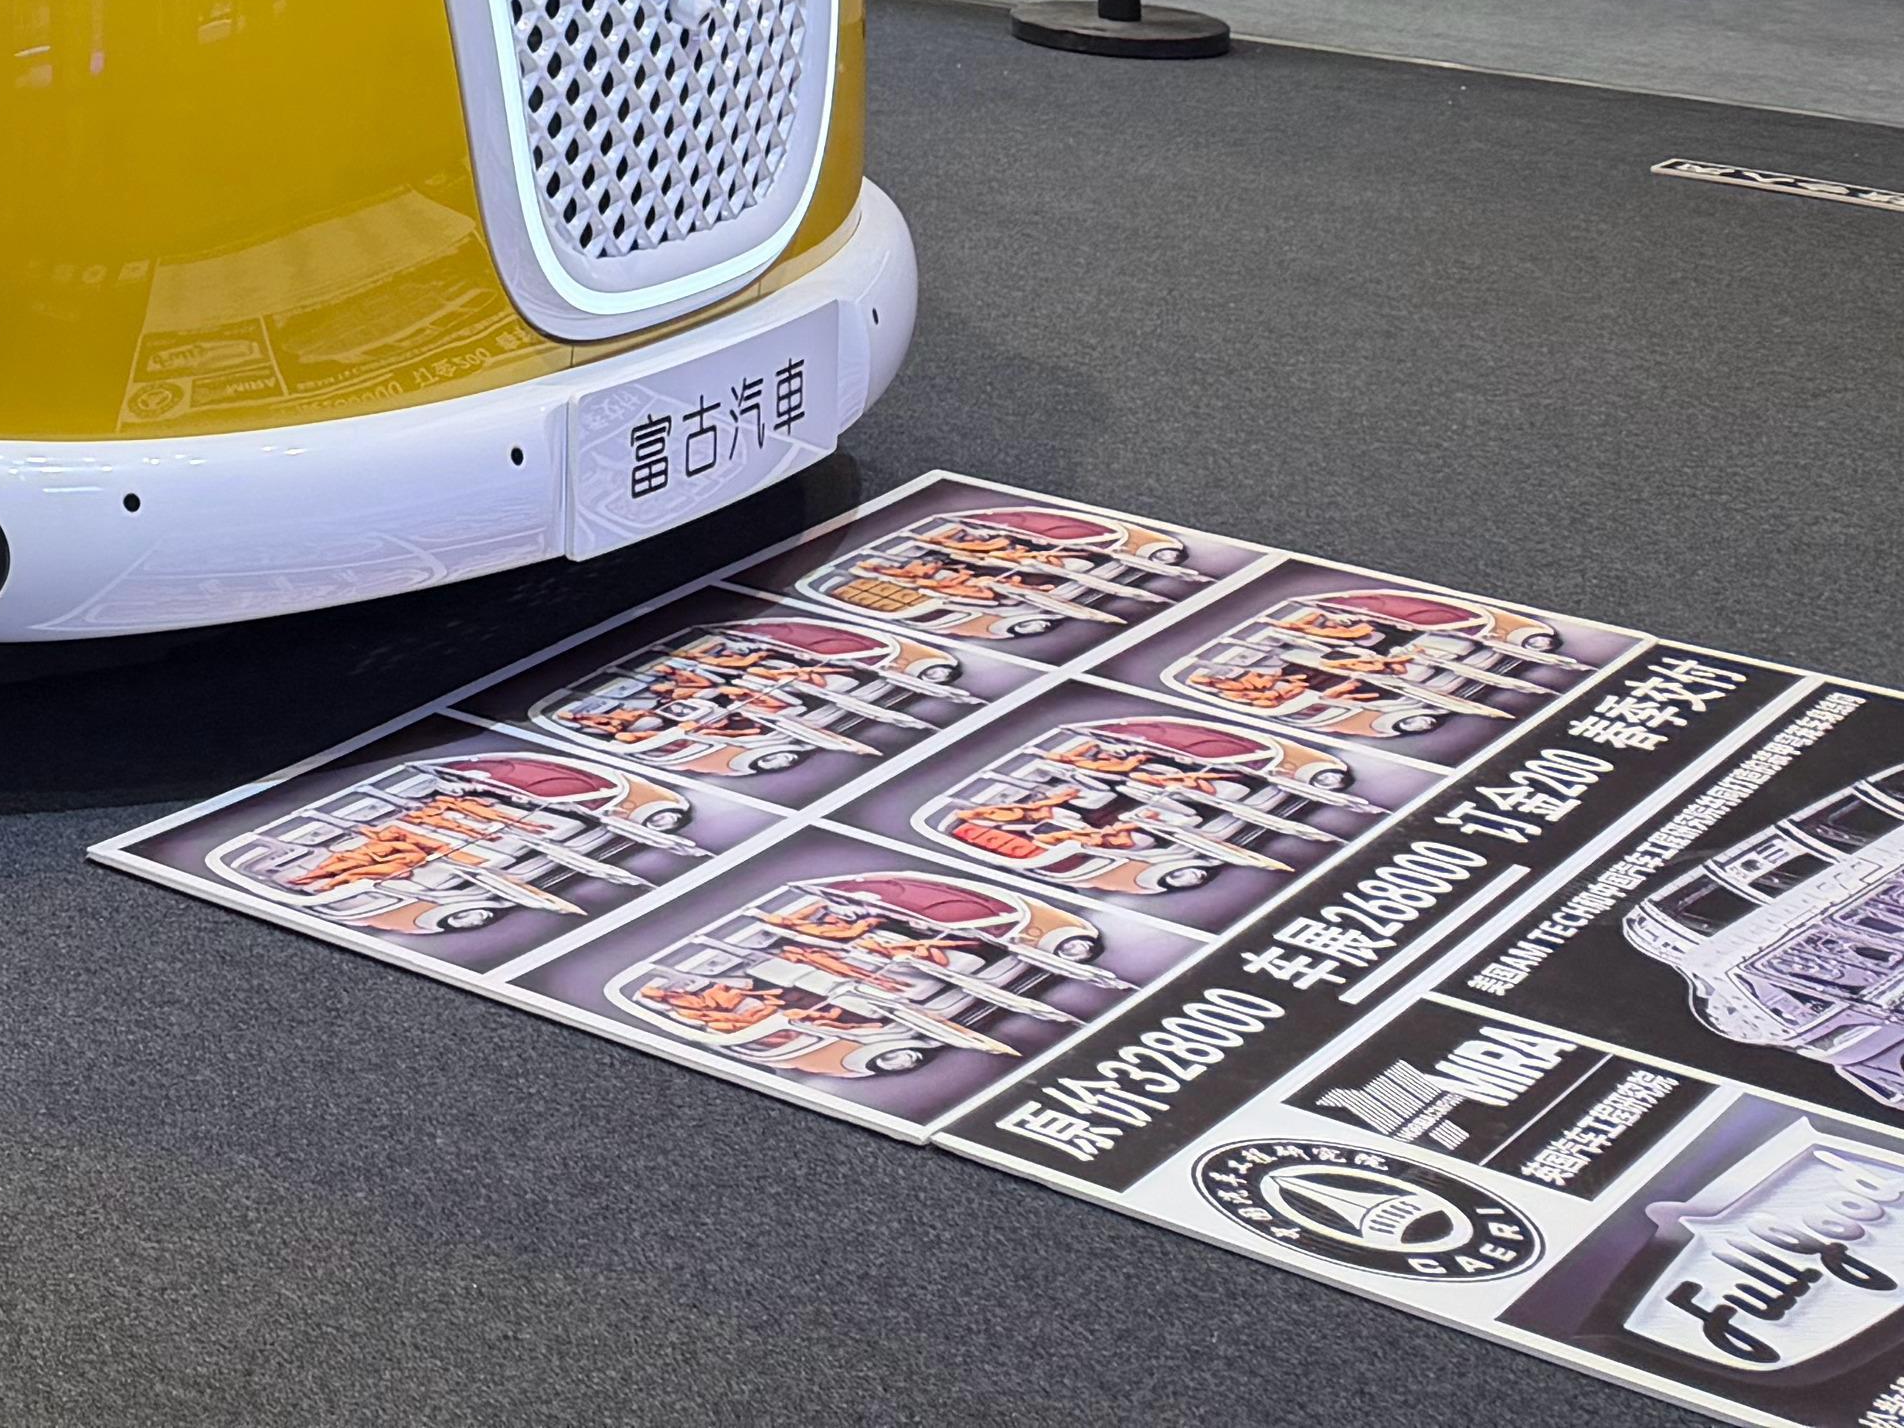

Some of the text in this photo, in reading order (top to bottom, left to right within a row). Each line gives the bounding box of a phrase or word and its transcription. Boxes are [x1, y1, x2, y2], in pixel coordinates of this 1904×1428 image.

[630, 357, 806, 499] 富古汽車
[995, 658, 1748, 1162] 原价328000 车展268000 订金200 春季交付
[1423, 1026, 1579, 1107] MIRA
[1520, 1069, 1681, 1187] 英国汽车工程研究院
[1407, 1206, 1526, 1274] CAERI
[1665, 1149, 1904, 1364] Fullgood
